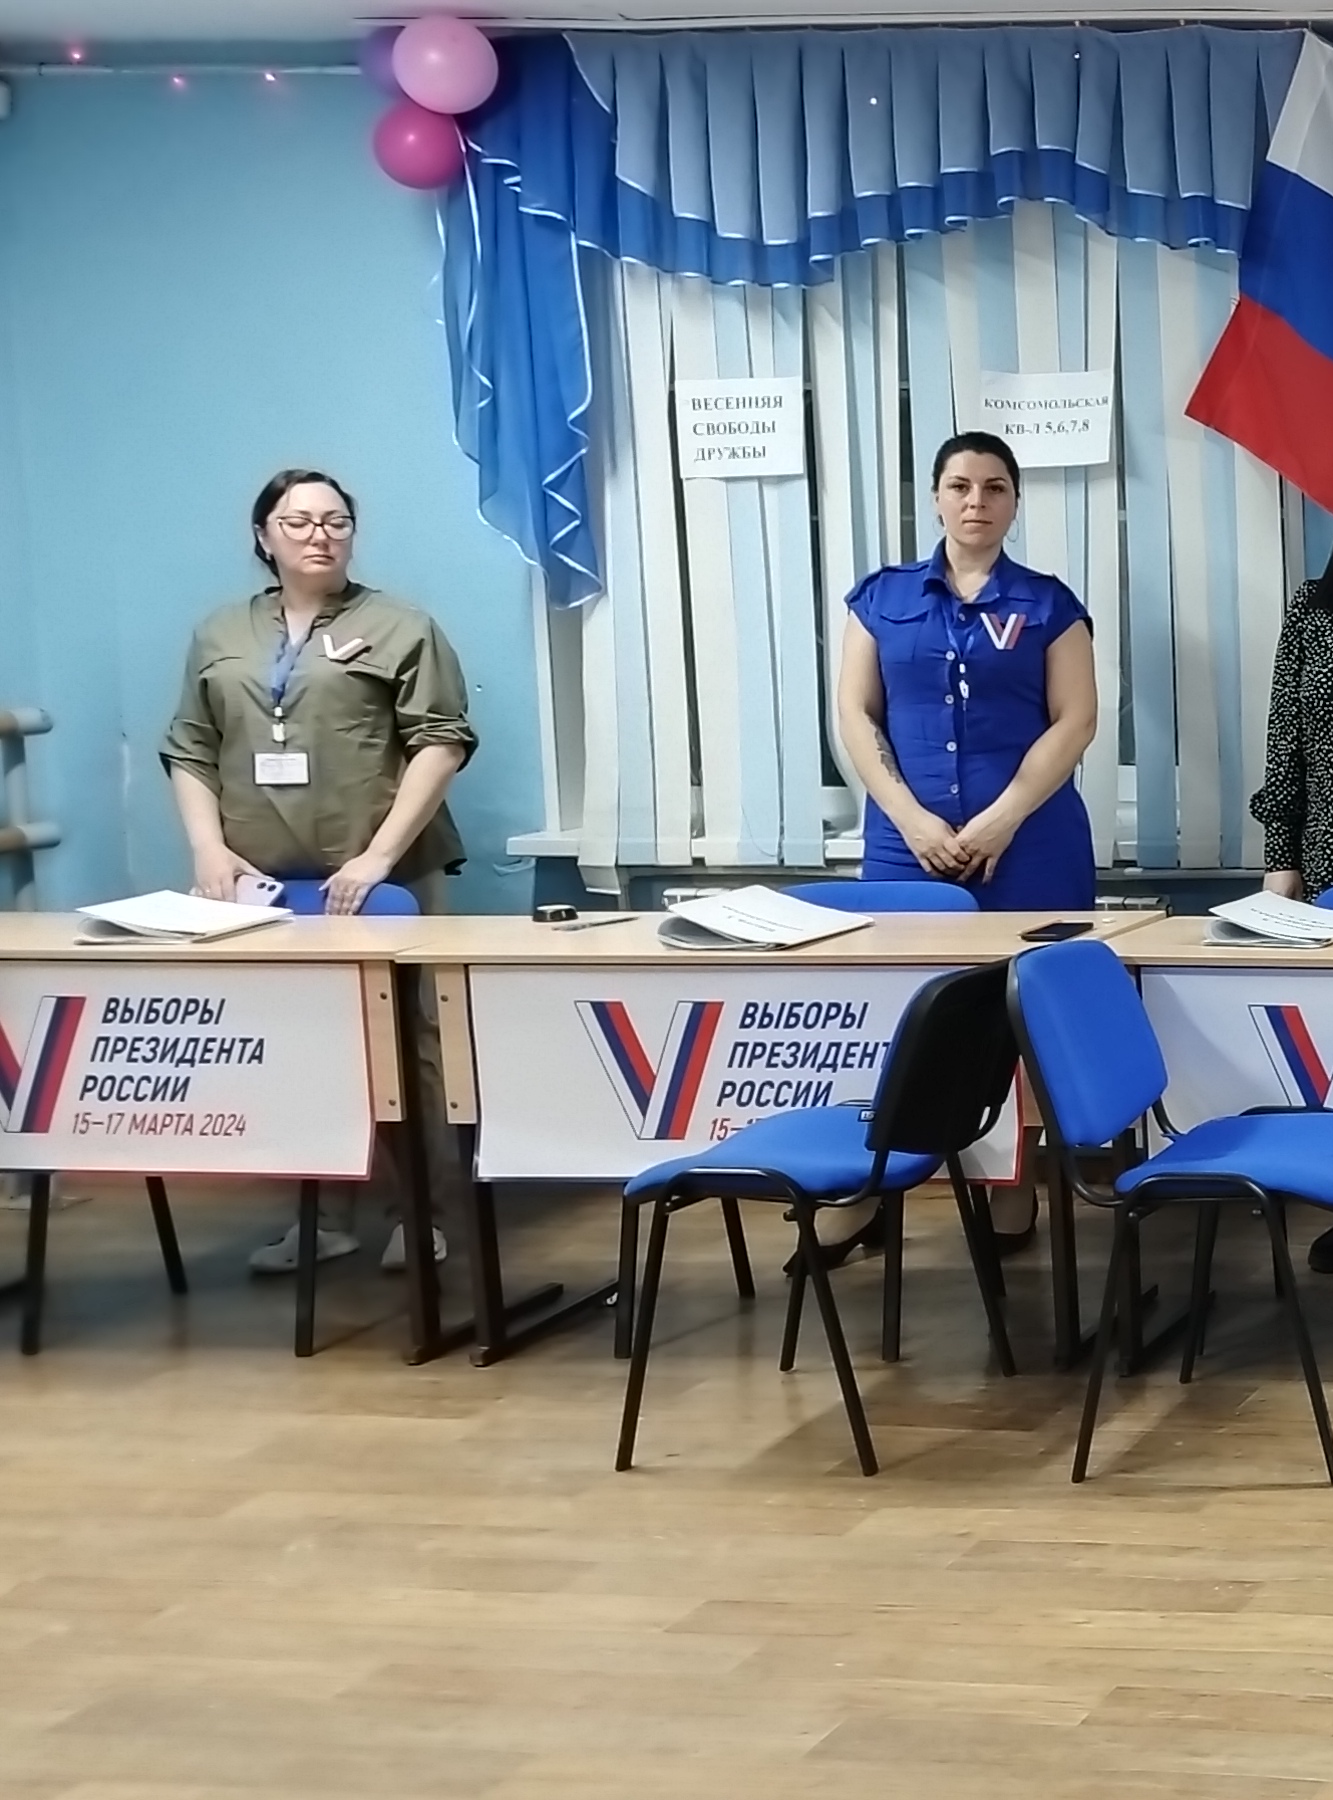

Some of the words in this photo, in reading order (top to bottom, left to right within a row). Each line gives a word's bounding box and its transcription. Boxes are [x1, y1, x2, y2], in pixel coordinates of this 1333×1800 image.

[690, 395, 783, 411] ВЕСЕННЯЯ
[692, 420, 776, 436] СВОБОДЫ
[693, 445, 767, 463] ДРУЖБЫ
[101, 997, 226, 1025] ВЫБОРЫ
[738, 1002, 869, 1029] ВЫБОРЫ
[90, 1036, 265, 1068] ПРЕЗИДЕНТА
[727, 1041, 891, 1073] ПРЕЗИДЕНТ
[79, 1074, 191, 1102] РОССИИ
[716, 1080, 834, 1107] РОССИИ
[128, 1113, 194, 1136] МАРТА
[199, 1113, 247, 1137] 2024
